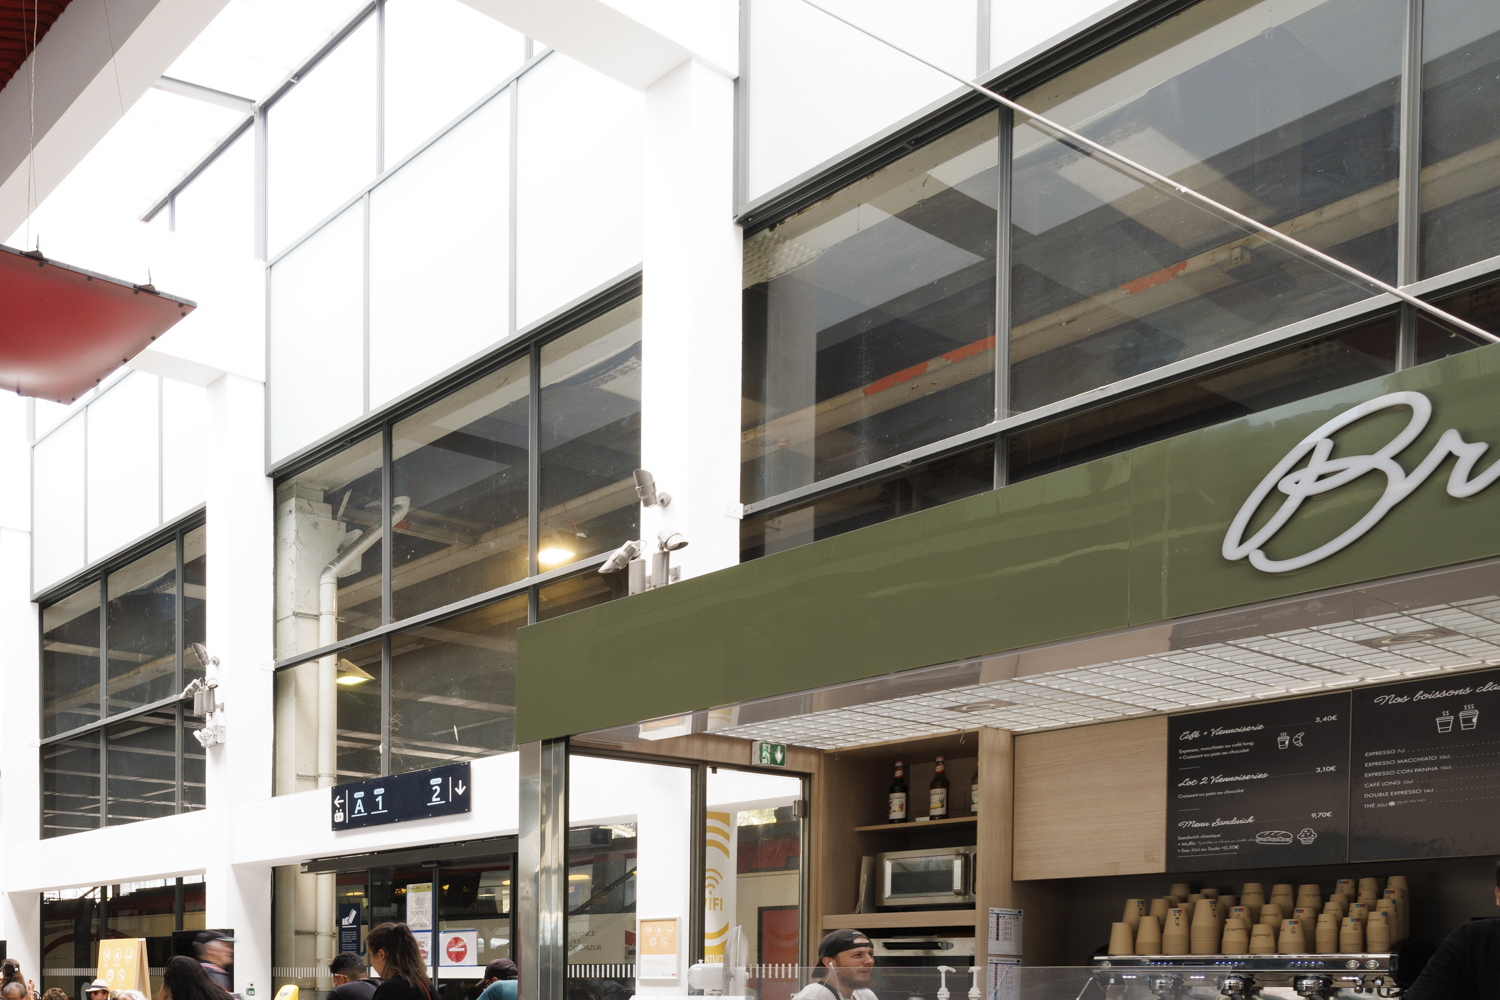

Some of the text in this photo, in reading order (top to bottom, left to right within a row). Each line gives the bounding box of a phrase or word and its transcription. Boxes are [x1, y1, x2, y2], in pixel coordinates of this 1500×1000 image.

[1374, 694, 1410, 705] Nos
[1413, 686, 1473, 701] boissons
[1315, 715, 1337, 723] 3,40€
[1179, 724, 1265, 740] Café Viennoiserie
[1365, 749, 1395, 757] EXPRESSO
[1397, 755, 1437, 764] MACCHIATO
[1178, 778, 1197, 786] Lot
[1211, 772, 1268, 785] Viennoiseries
[1365, 770, 1395, 778] EXPRESSO
[1390, 788, 1422, 796] EXPRESSO
[354, 786, 441, 814] A 1 2
[1211, 816, 1255, 827] Sandwich
[705, 897, 723, 911] IFI
